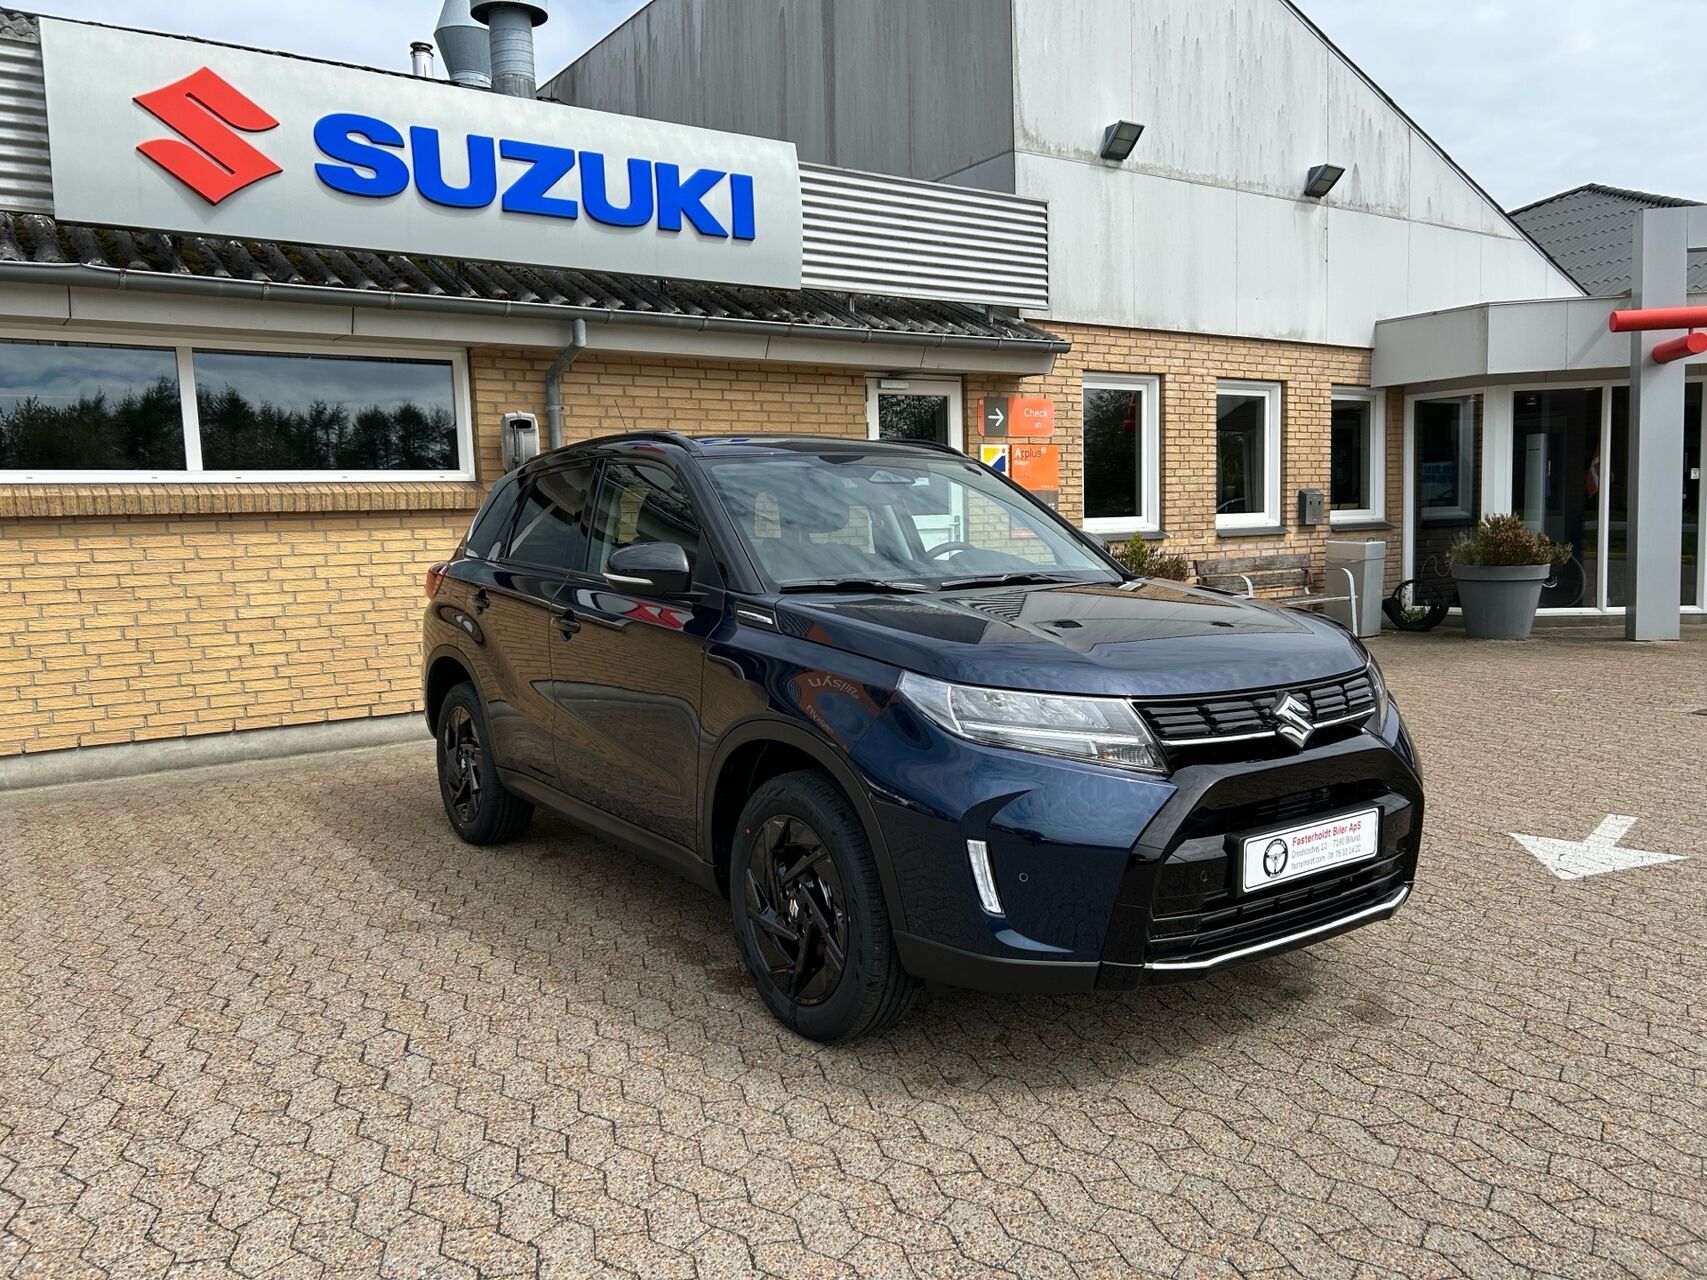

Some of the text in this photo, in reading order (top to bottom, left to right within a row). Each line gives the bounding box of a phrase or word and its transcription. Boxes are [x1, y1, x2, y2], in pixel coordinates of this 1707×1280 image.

[313, 112, 756, 241] SUZUKI
[1024, 408, 1048, 418] Check
[1292, 829, 1331, 847] Fasterholdt
[1332, 826, 1347, 837] Biler
[1349, 820, 1362, 833] ApS
